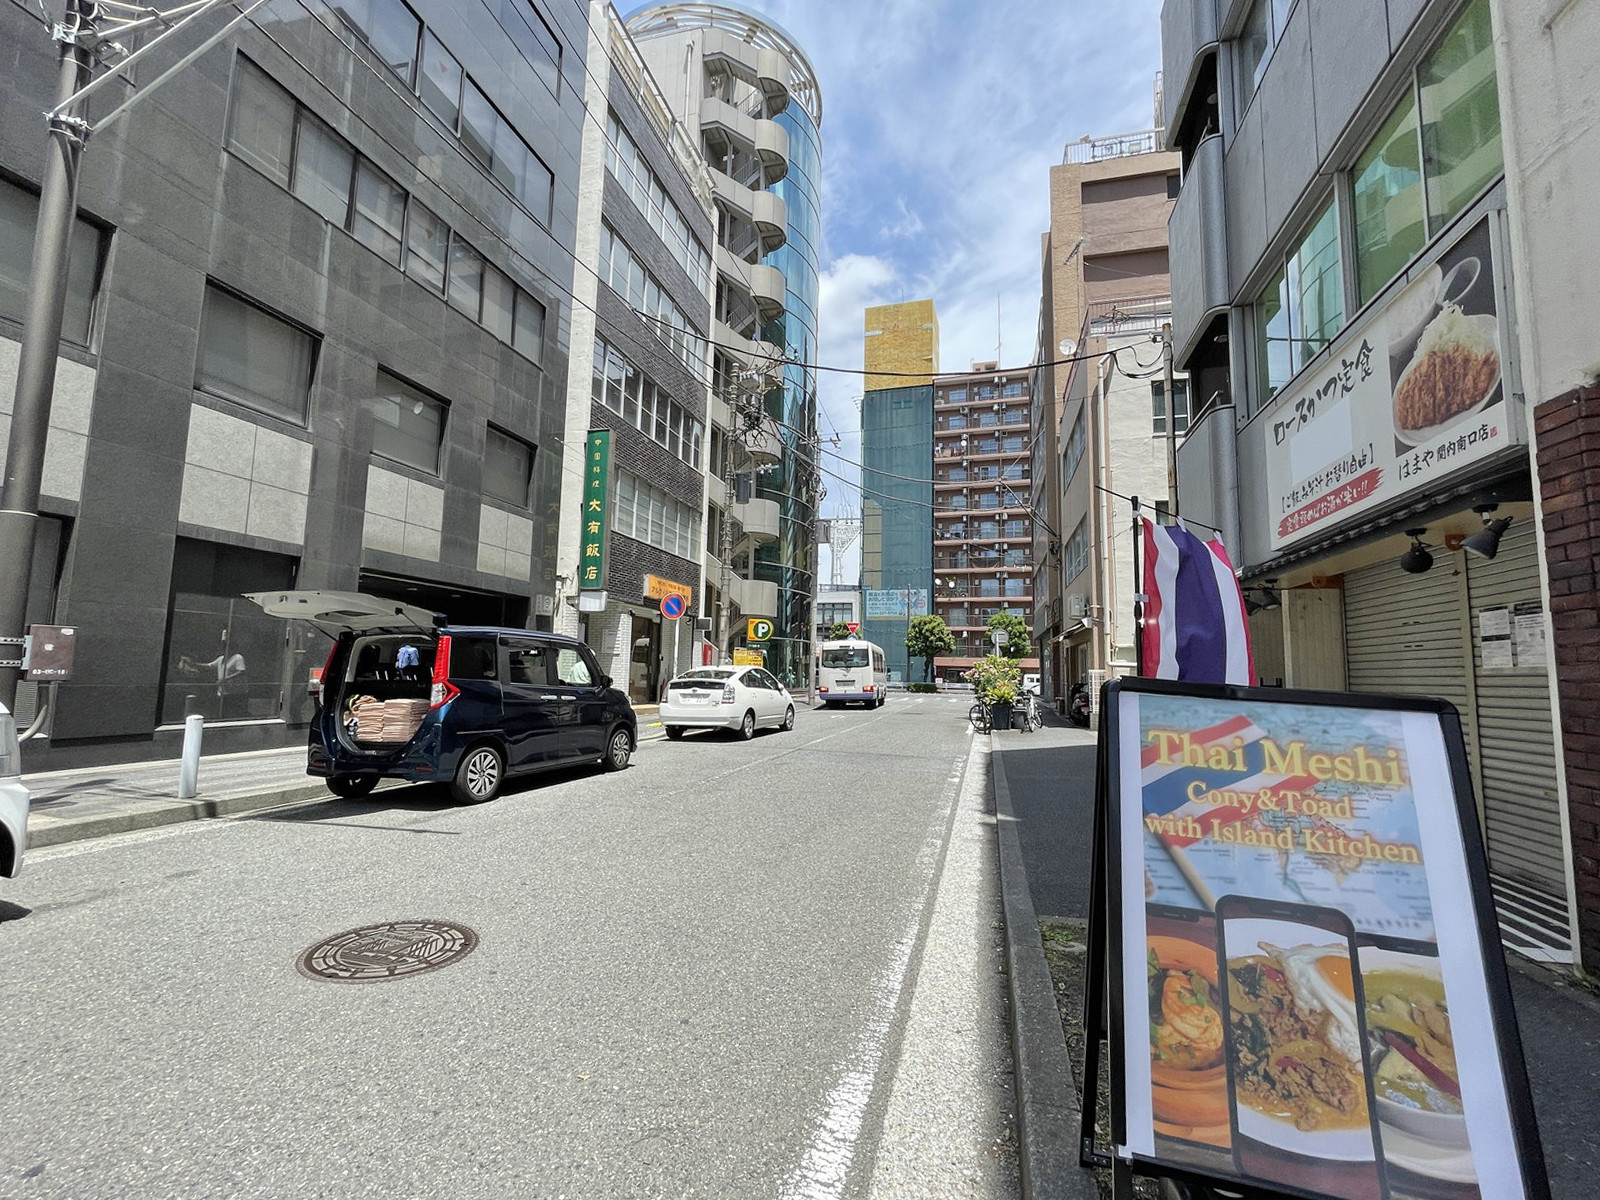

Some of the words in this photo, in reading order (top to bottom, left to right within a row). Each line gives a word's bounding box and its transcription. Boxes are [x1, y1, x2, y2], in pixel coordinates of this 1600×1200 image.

[1273, 338, 1375, 446] ロースかつ定食
[1398, 448, 1434, 481] はまや
[1436, 423, 1489, 462] 関内南口店
[585, 499, 602, 581] 大有飯店
[757, 623, 769, 638] P
[1148, 730, 1247, 772] Thai
[1260, 738, 1405, 786] Meshi
[1187, 781, 1352, 818] Cony&Toad
[1145, 815, 1202, 839] with
[1211, 819, 1294, 849] Island
[1303, 827, 1422, 864] Kitchen
